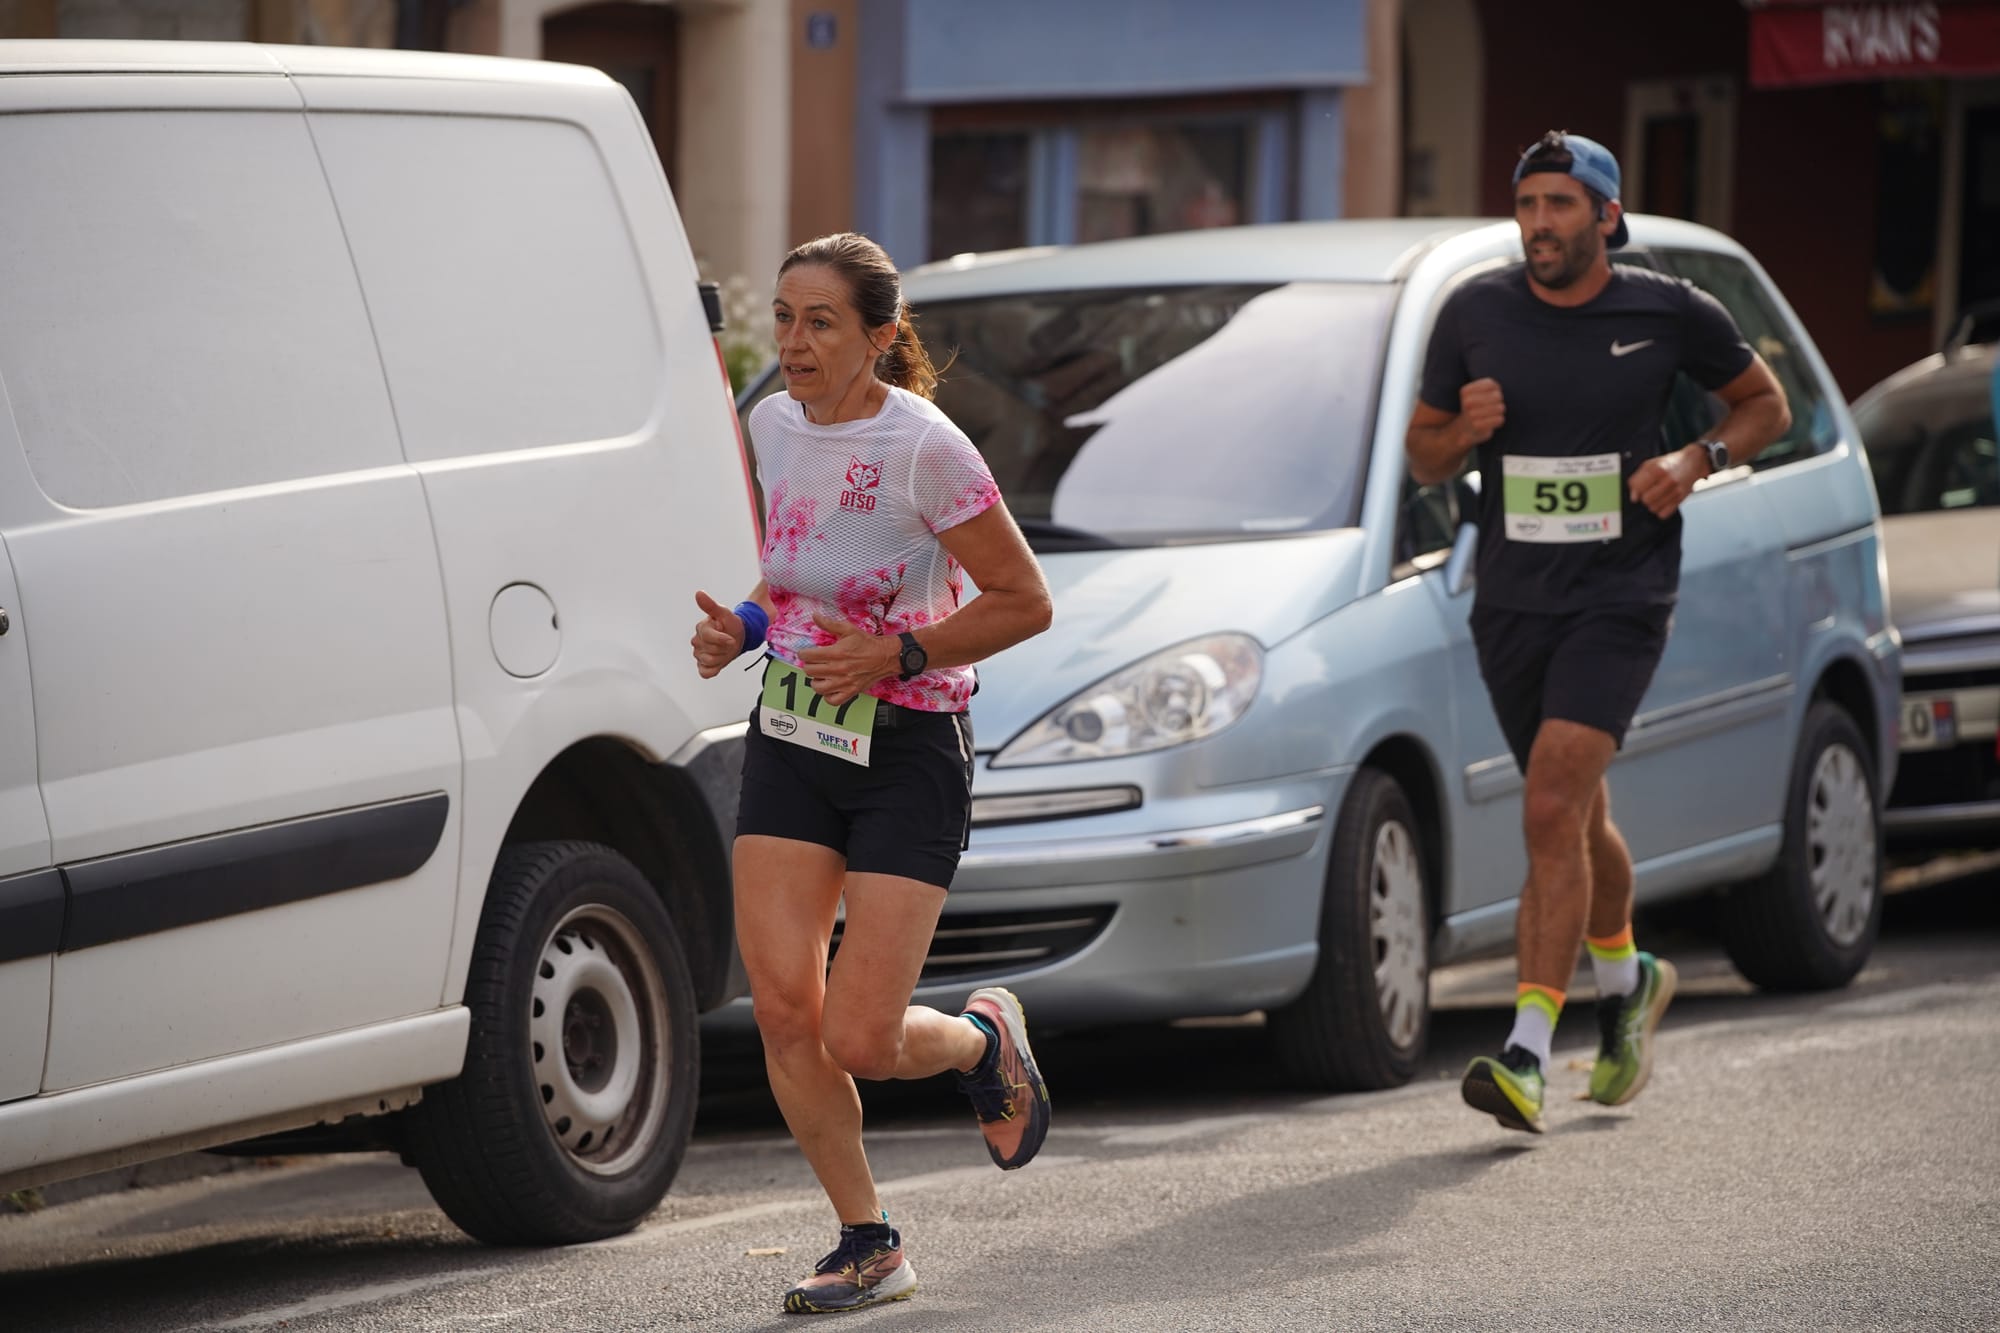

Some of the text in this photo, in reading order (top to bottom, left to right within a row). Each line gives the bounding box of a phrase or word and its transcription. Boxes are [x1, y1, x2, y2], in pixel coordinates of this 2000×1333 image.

[1823, 4, 1941, 68] RYAN'S
[840, 490, 876, 511] OTSO
[1534, 482, 1588, 513] 59
[770, 718, 794, 731] BFP
[816, 731, 849, 748] TUFF'S
